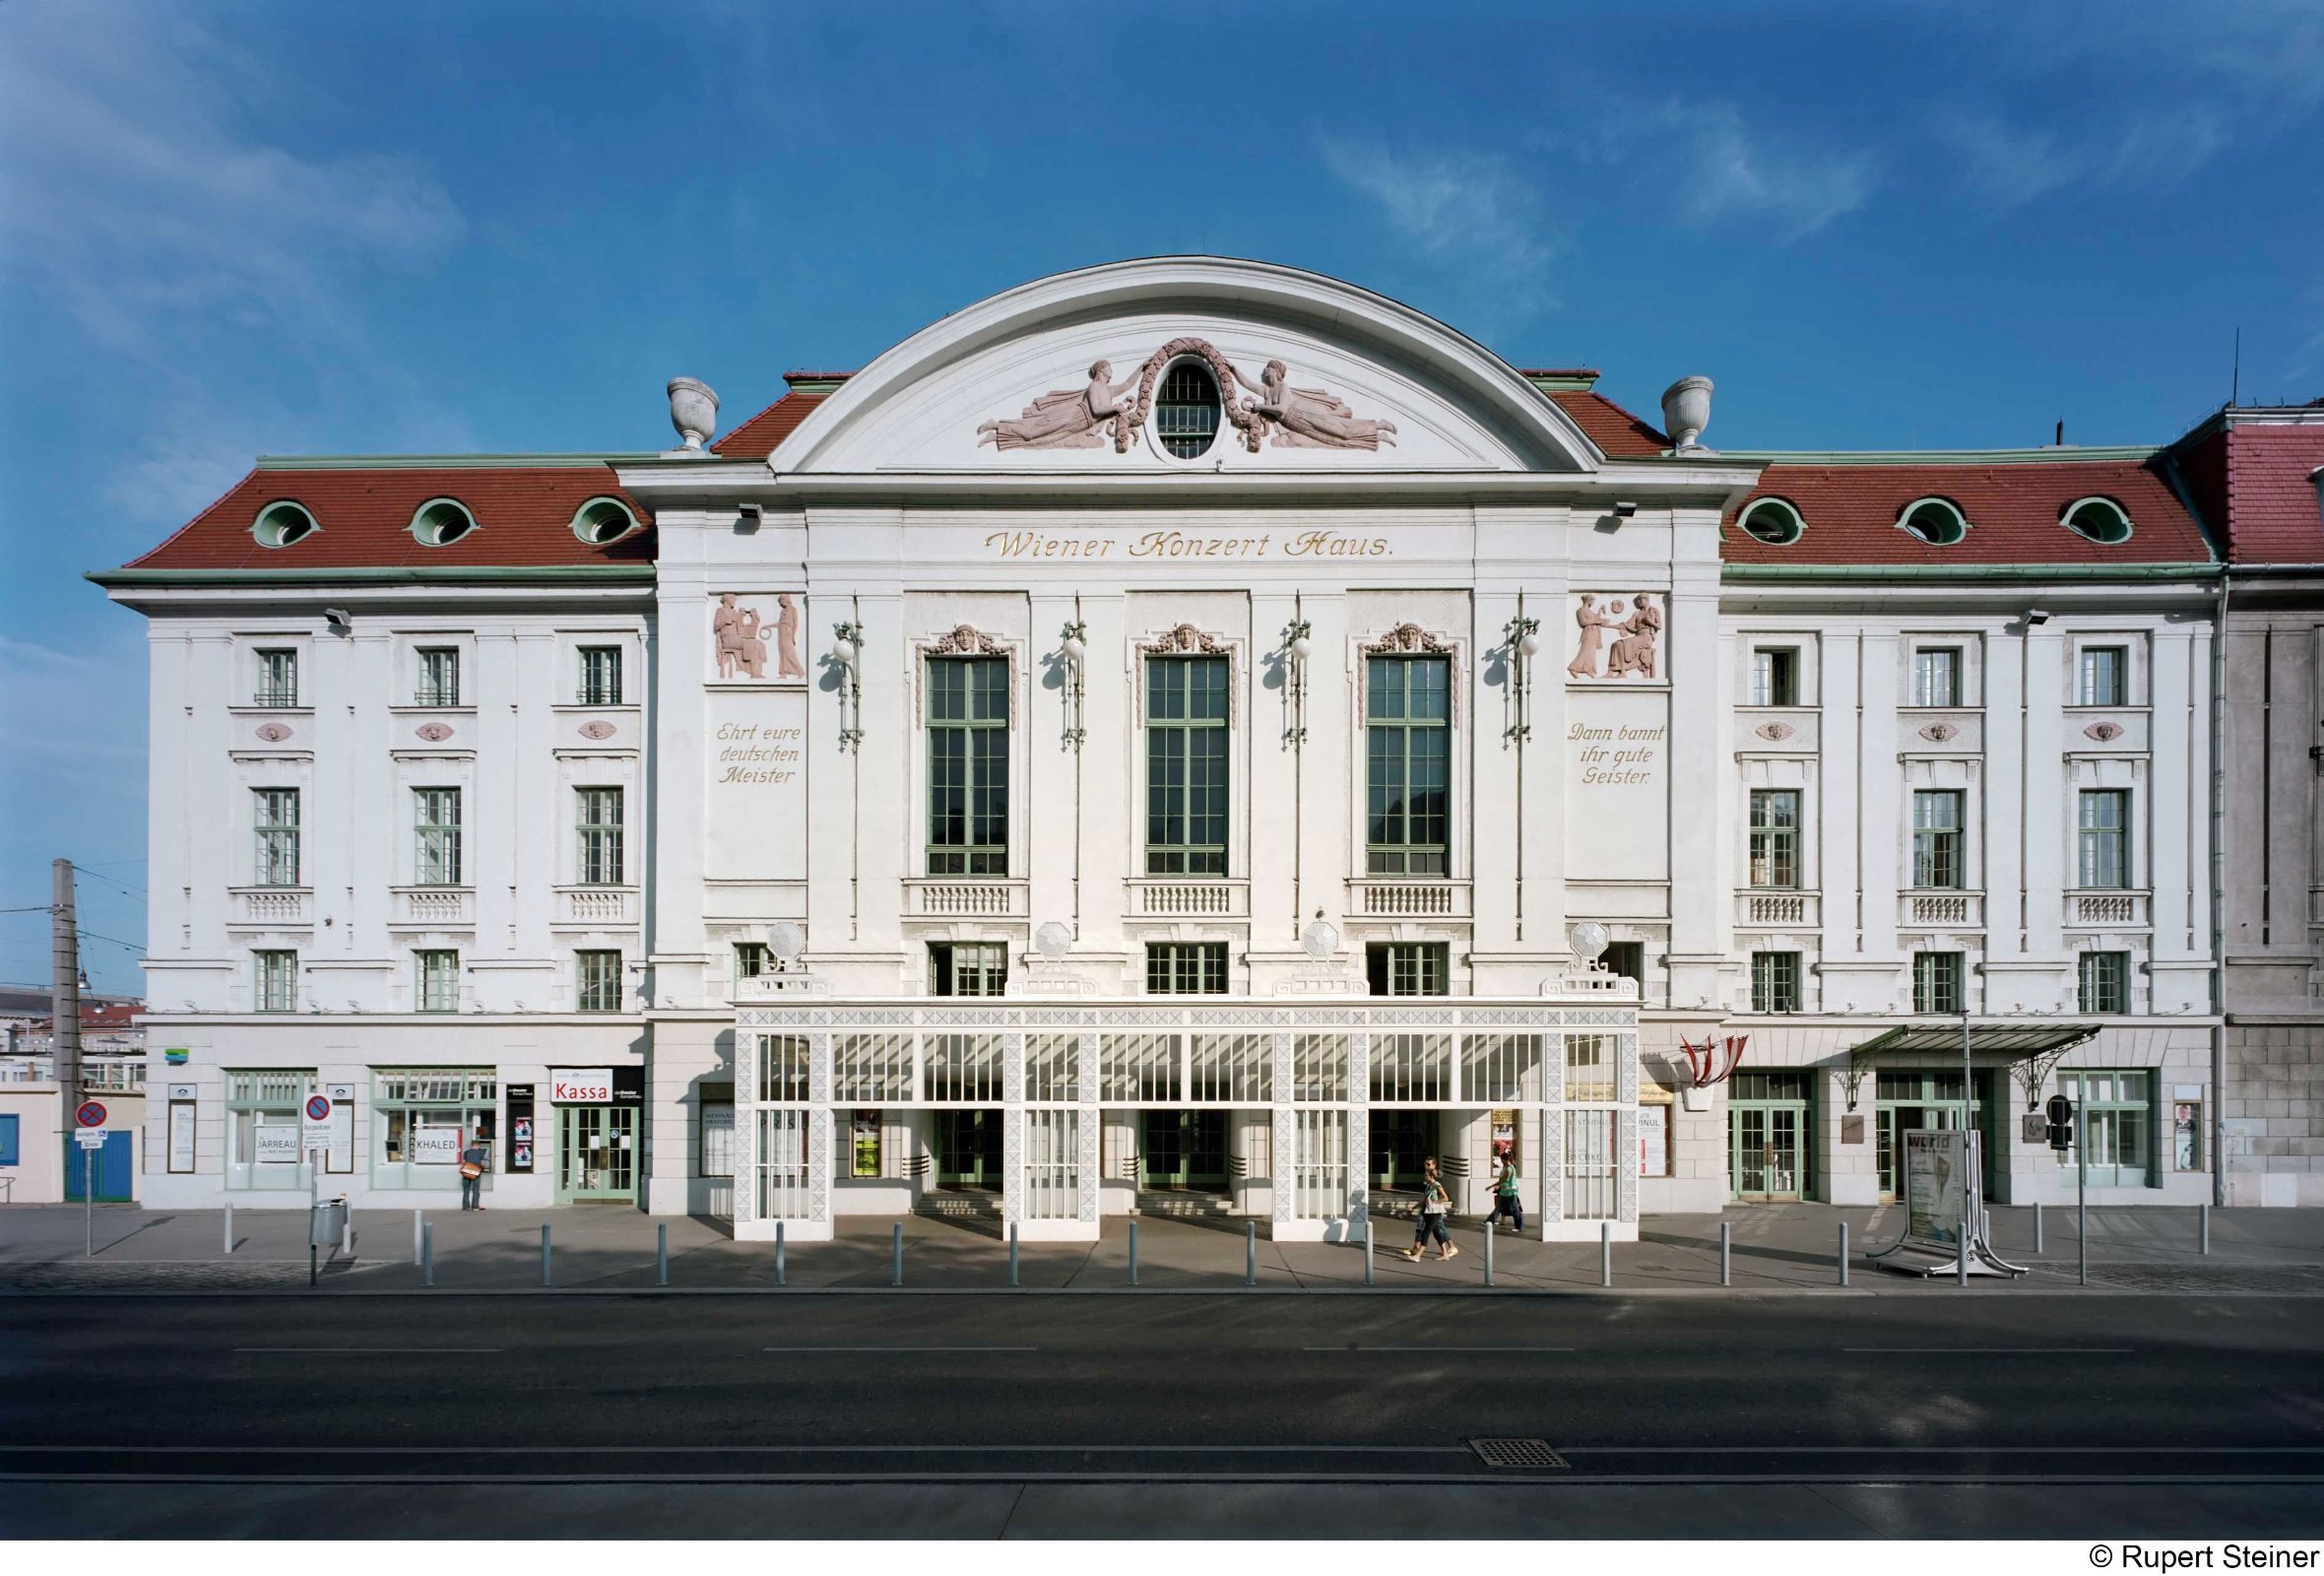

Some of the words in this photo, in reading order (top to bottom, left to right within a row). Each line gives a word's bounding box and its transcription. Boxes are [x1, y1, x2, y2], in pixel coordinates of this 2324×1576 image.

[983, 531, 1116, 558] Wiener
[1127, 531, 1268, 558] Konzert
[1283, 531, 1394, 558] Haus.
[717, 722, 759, 741] Ehrt
[763, 727, 802, 741] eure
[1567, 722, 1613, 742] Dann
[1618, 724, 1666, 741] bannt
[719, 745, 800, 762] deutschen
[1580, 746, 1609, 762] ihr
[1613, 747, 1653, 767] gute
[718, 765, 796, 784] Meister
[555, 1083, 608, 1099] Kassa
[258, 1140, 296, 1149] JARREAU
[417, 1140, 456, 1149] KHALED
[1908, 1135, 1950, 1149] world
